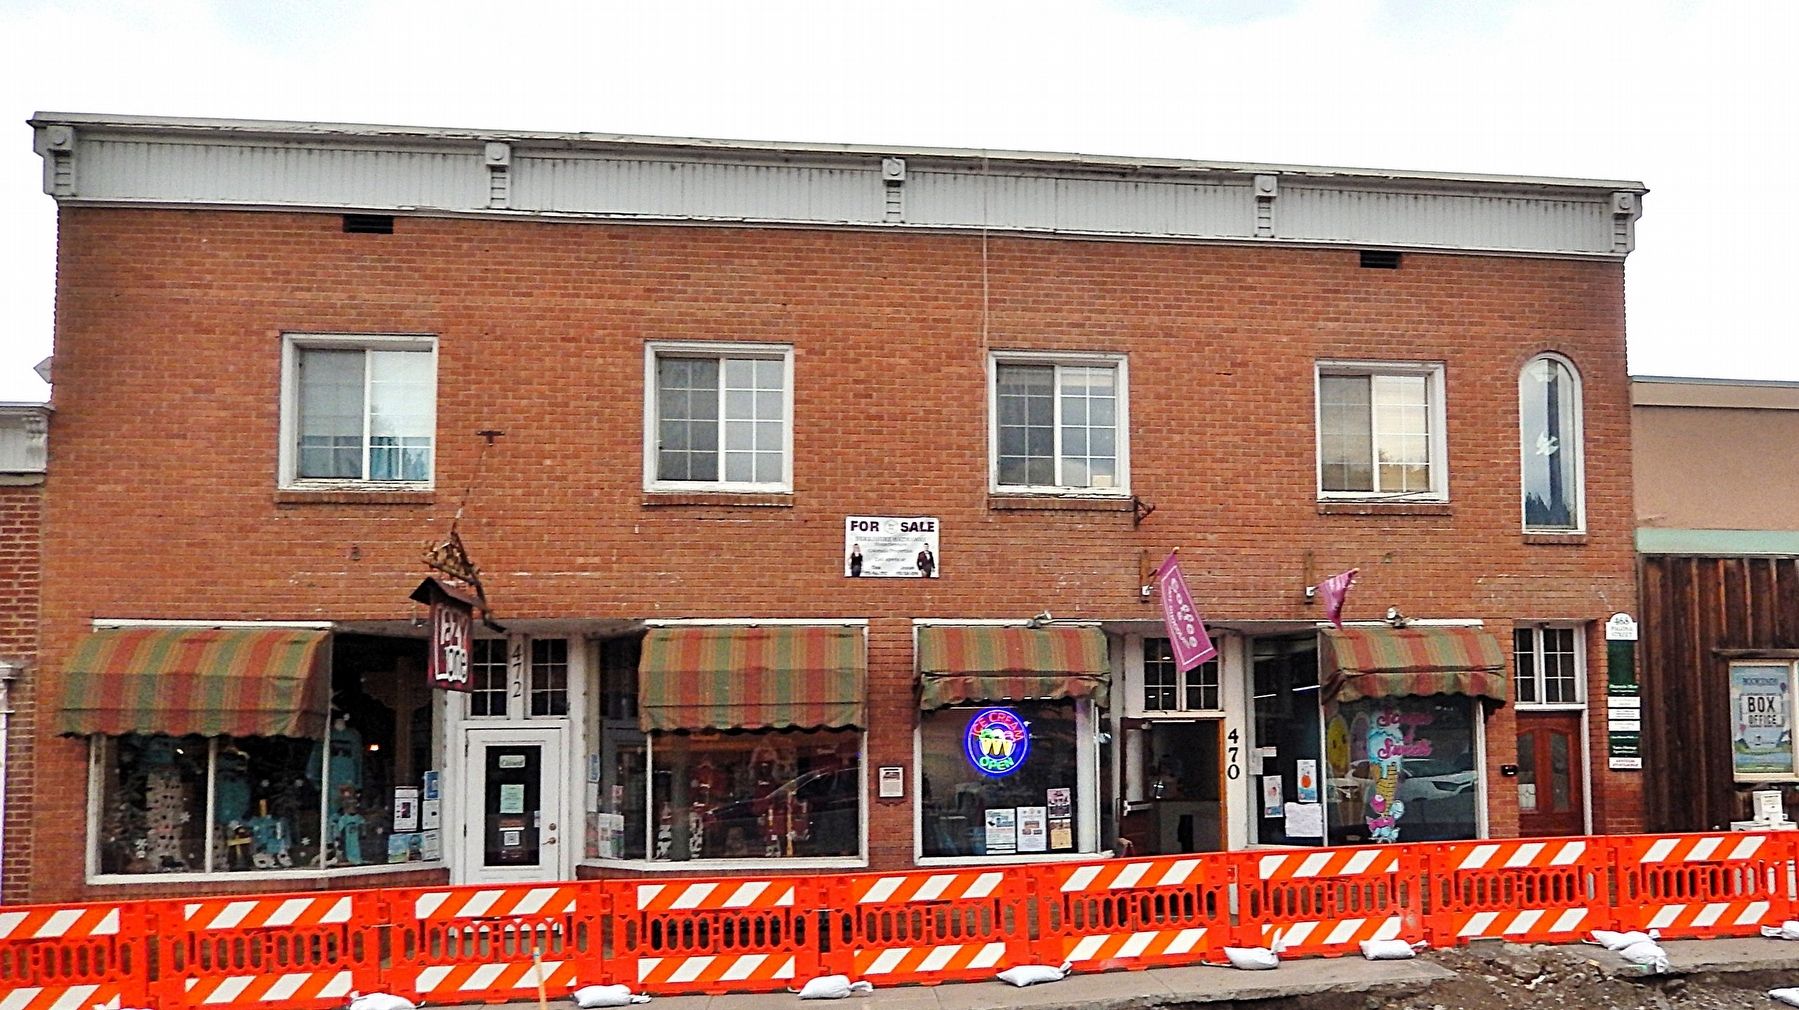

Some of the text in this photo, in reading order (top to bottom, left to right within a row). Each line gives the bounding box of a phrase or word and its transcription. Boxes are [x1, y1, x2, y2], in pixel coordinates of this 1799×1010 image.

[850, 520, 935, 533] FOR SALE
[511, 643, 523, 699] 472
[1747, 696, 1776, 713] BOX
[970, 711, 1025, 743] ICE CREAM
[1748, 714, 1778, 725] OFFICE
[1227, 727, 1241, 780] 470
[979, 756, 1015, 771] OPEN
